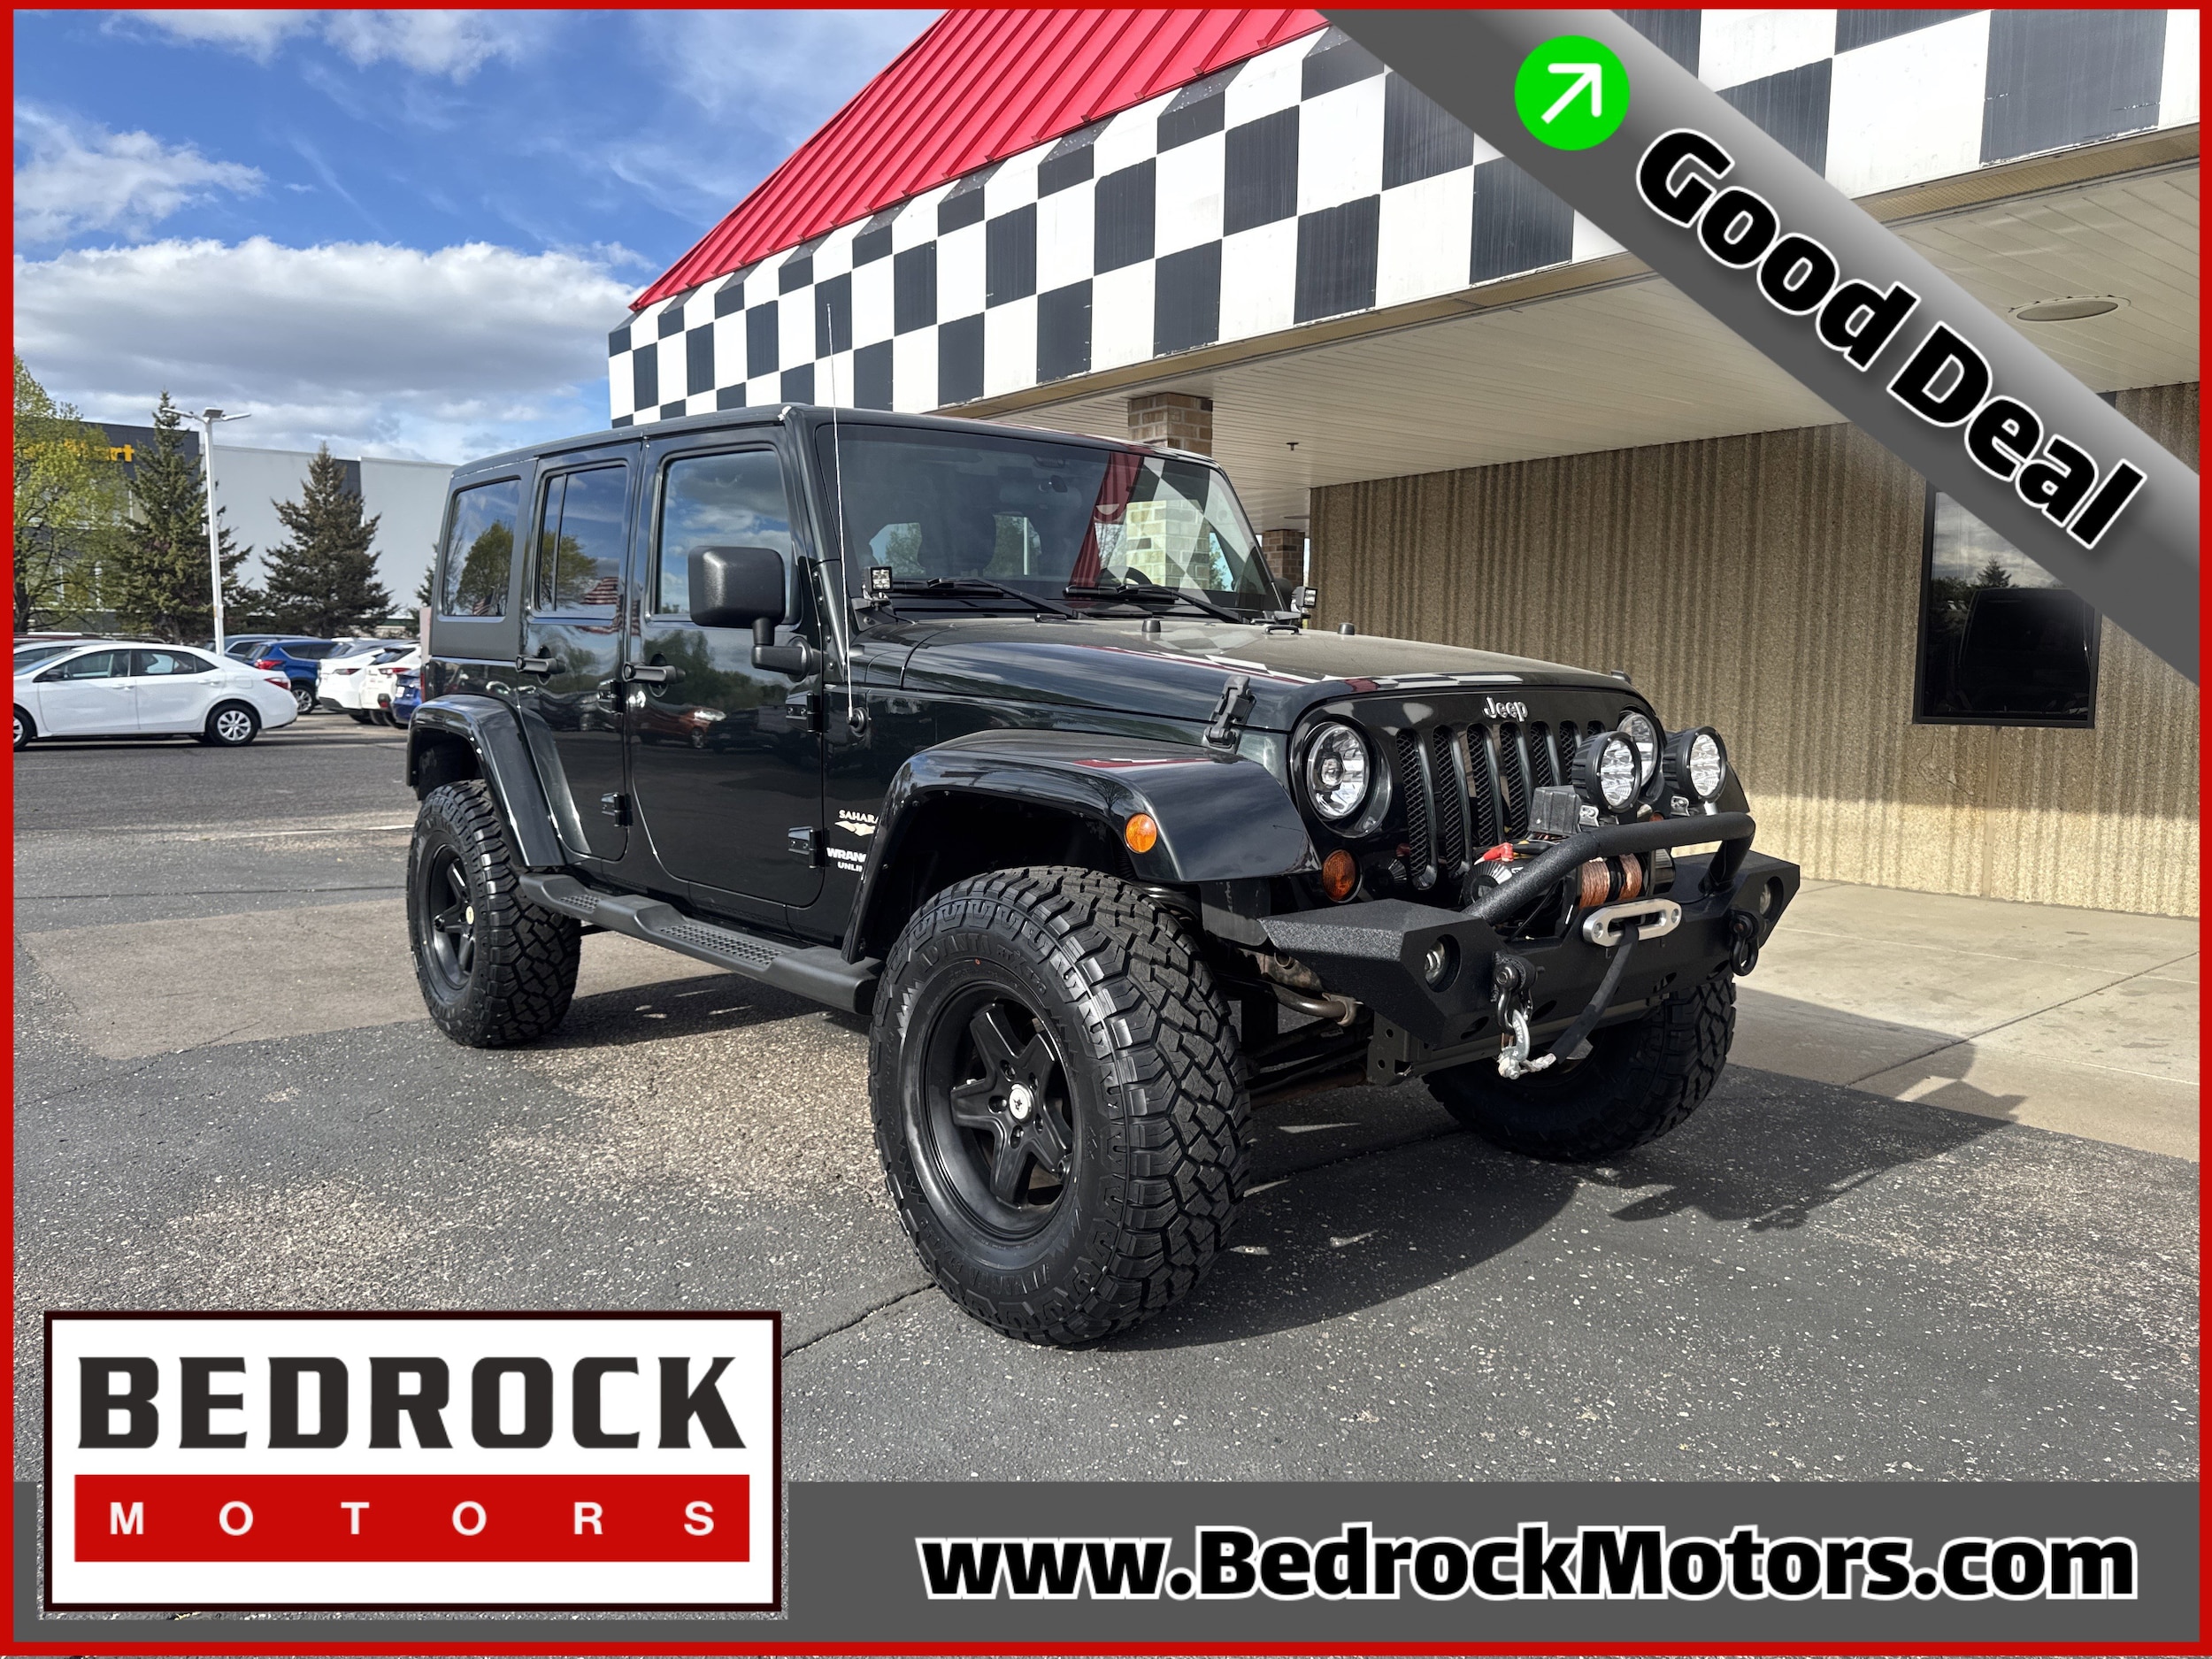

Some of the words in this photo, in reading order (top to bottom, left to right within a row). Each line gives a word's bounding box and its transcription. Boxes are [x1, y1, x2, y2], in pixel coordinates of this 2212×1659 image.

[1482, 695, 1528, 722] Jeep
[826, 847, 867, 863] WRAN
[918, 933, 991, 972] ADVANTA
